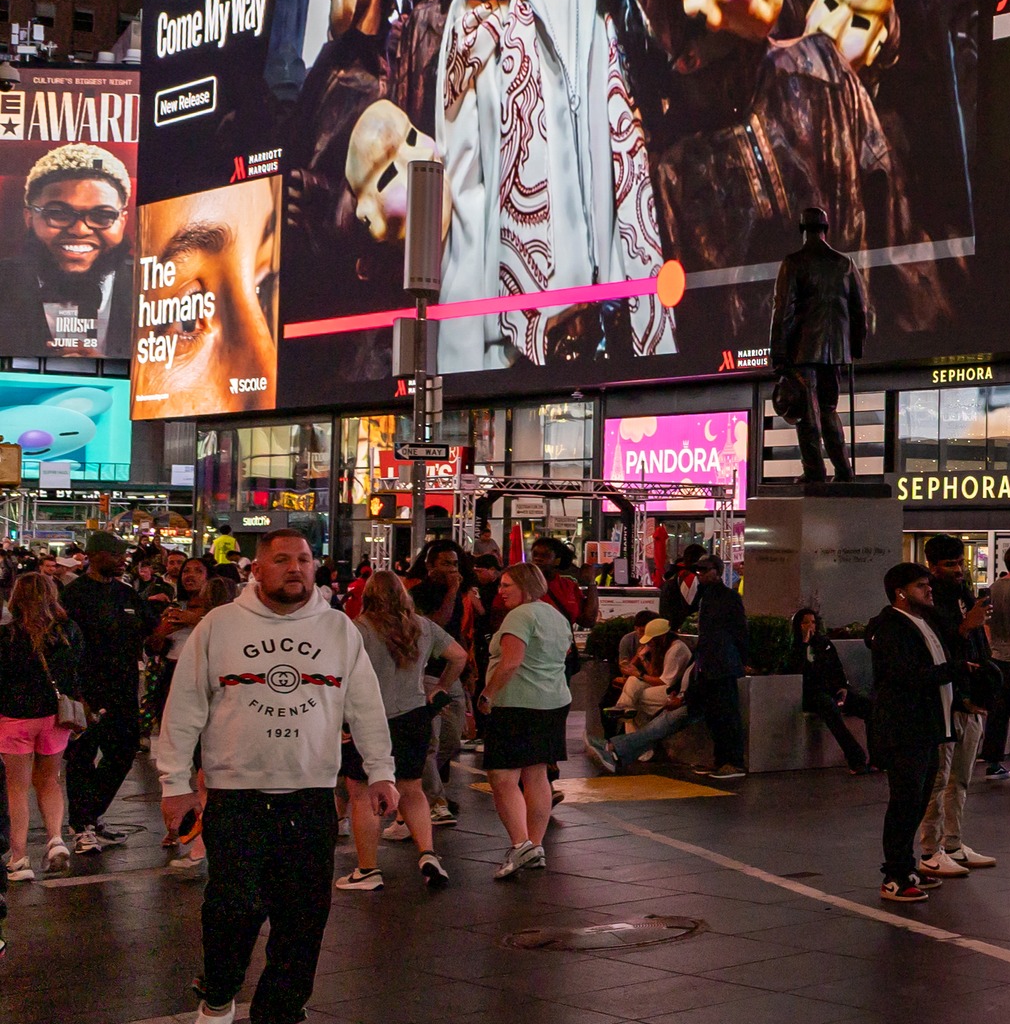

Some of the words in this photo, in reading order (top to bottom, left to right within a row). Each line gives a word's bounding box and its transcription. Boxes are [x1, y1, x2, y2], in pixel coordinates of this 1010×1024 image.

[156, 10, 202, 59] Come
[75, 77, 107, 85] BIGGEST
[160, 99, 178, 115] New
[179, 90, 210, 111] Release
[28, 92, 140, 143] AWARD
[248, 148, 283, 164] MARRIOTT
[248, 161, 278, 176] MARQUIS
[140, 255, 176, 291] The
[139, 290, 216, 328] humans
[51, 337, 79, 348] JUNE
[83, 338, 98, 348] 28
[137, 331, 178, 370] stay
[738, 358, 768, 367] MARQUIS
[932, 367, 993, 383] SEPHORA
[239, 377, 268, 393] scale
[402, 448, 419, 456] ONE
[425, 448, 443, 456] WAY
[626, 446, 722, 475] PANDORA
[243, 638, 322, 660] GUCCI
[248, 697, 317, 717] FIRENZE
[266, 728, 300, 738] 1921
